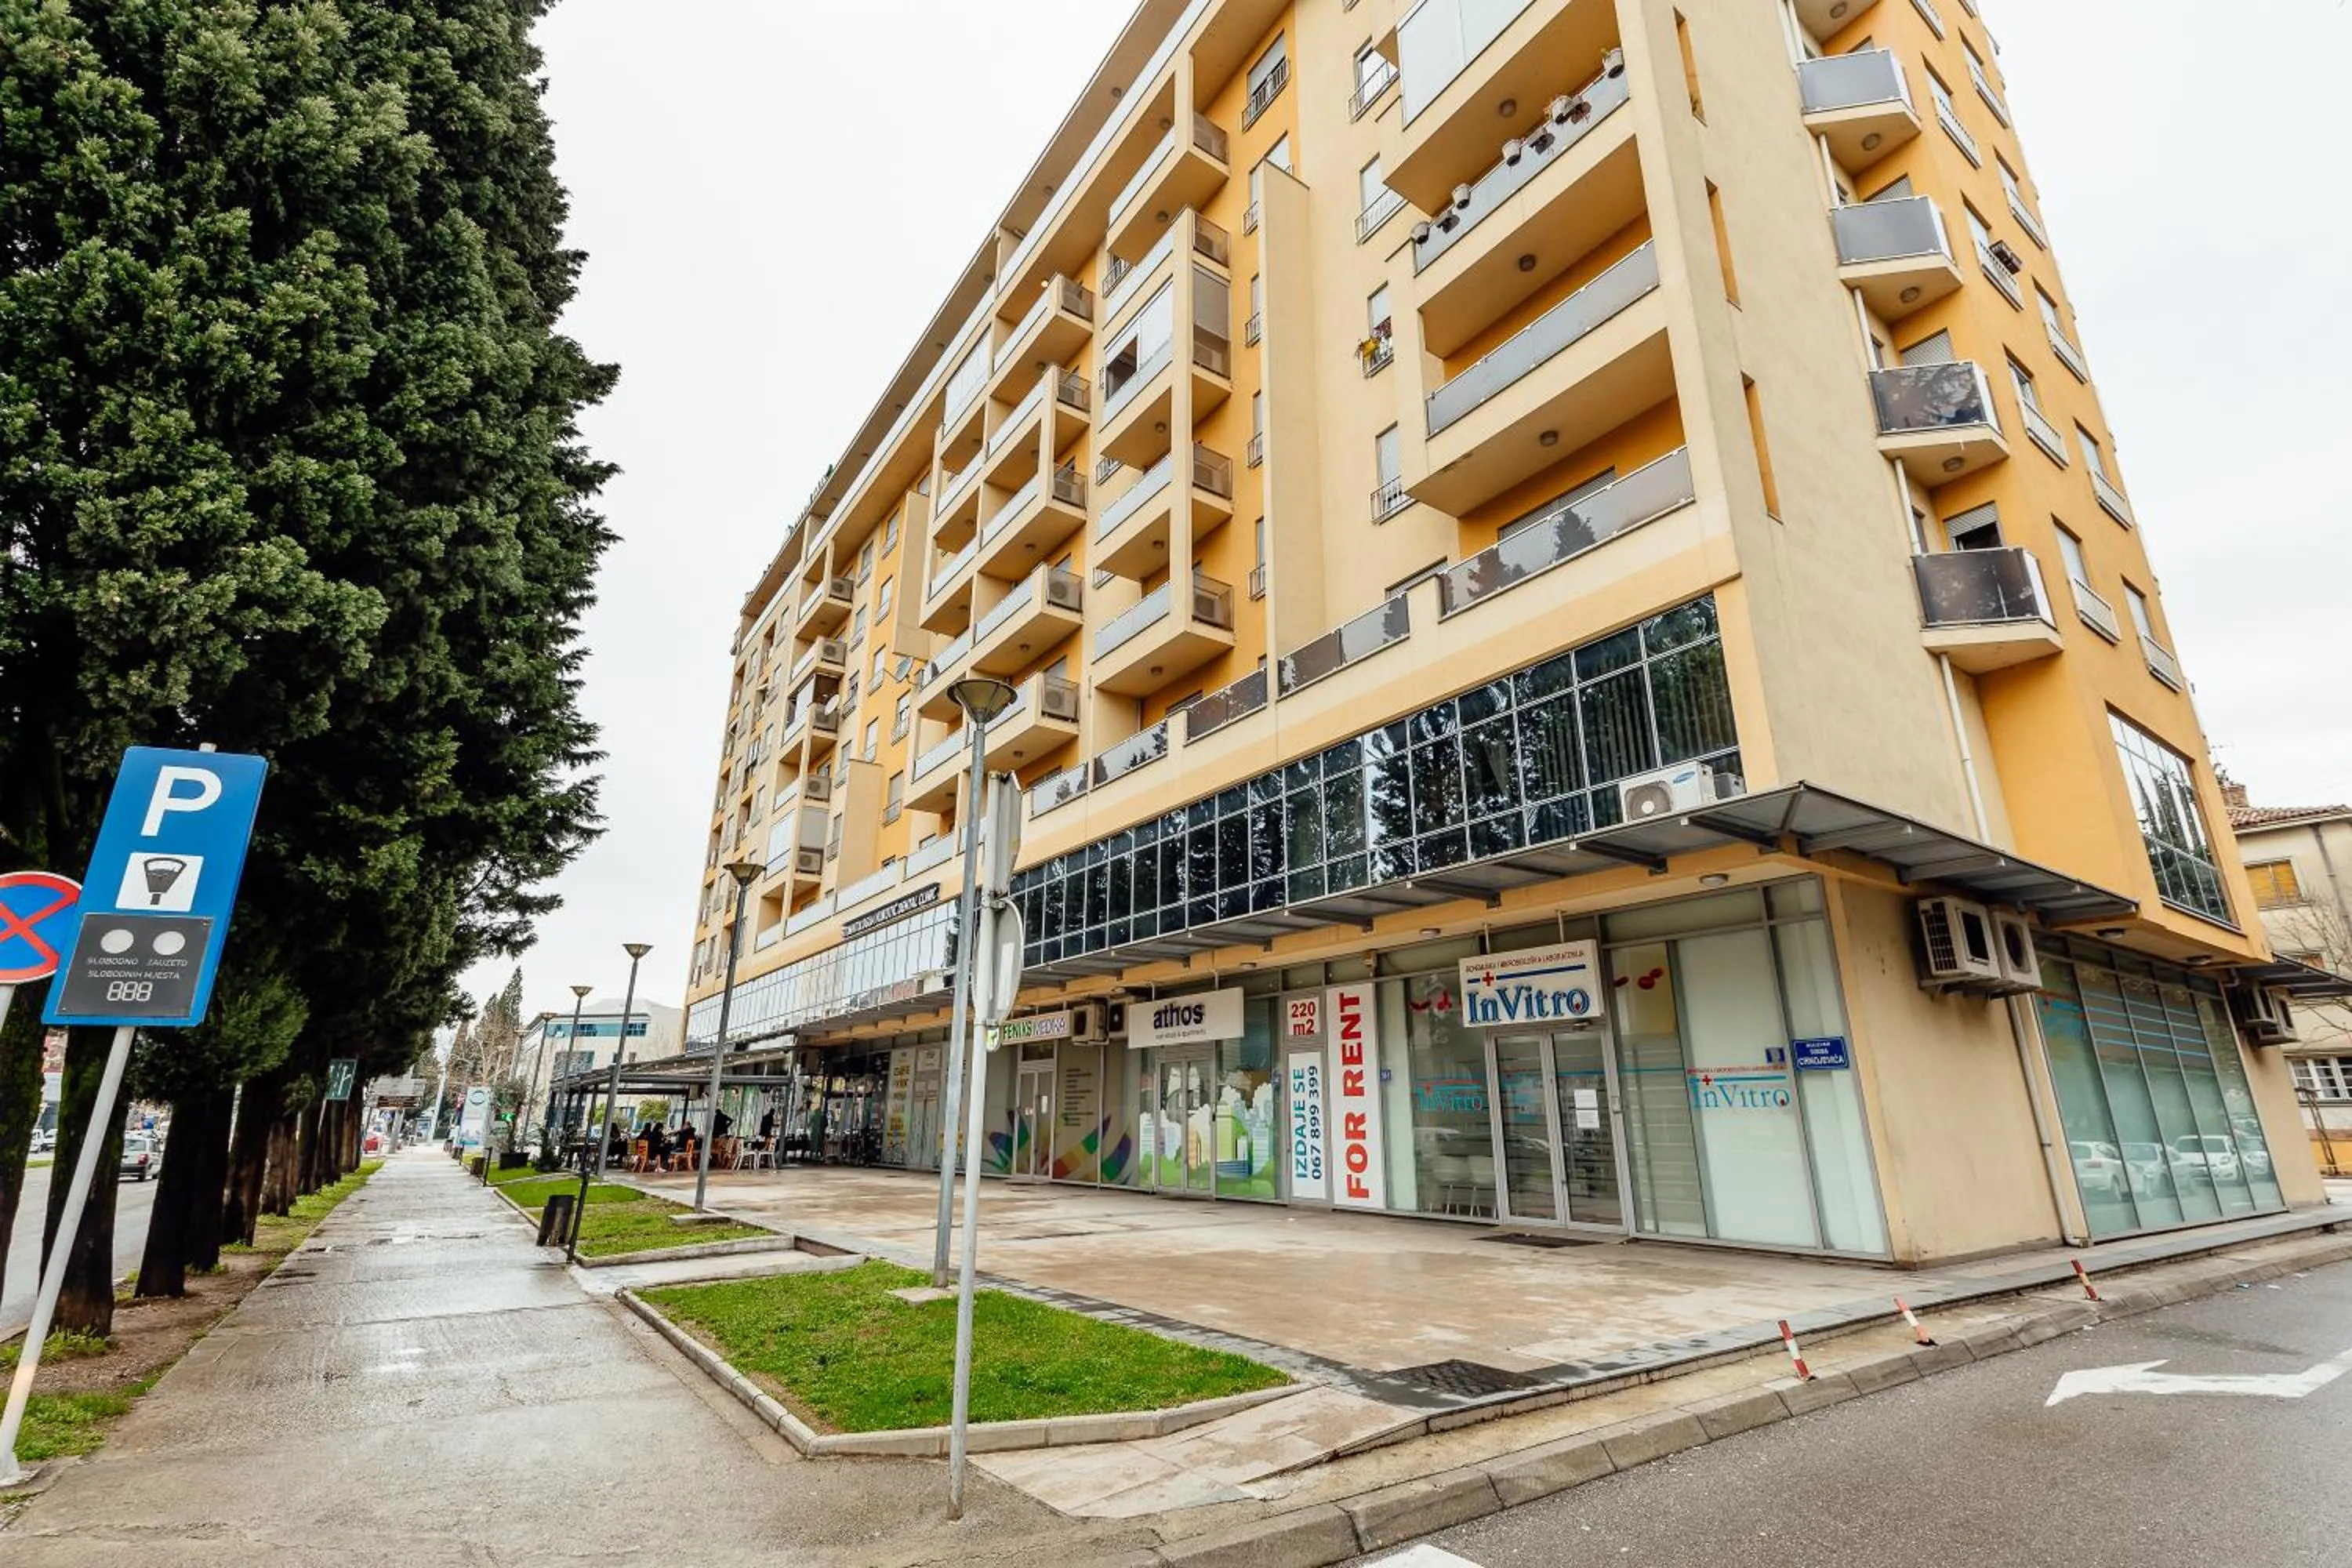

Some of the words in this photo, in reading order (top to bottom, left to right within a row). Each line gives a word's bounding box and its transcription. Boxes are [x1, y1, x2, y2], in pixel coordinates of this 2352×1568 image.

[140, 765, 222, 837] P
[87, 956, 139, 965] SLOBODNO
[88, 970, 143, 978] SLOBODNIH
[143, 971, 180, 979] MJESTA
[1154, 1003, 1205, 1029] athos
[1291, 1001, 1316, 1018] 220
[1467, 985, 1590, 1024] InVitro
[1003, 1021, 1032, 1039] FENIKS
[1293, 1019, 1315, 1035] m2
[1339, 992, 1365, 1098] RENT
[1293, 1068, 1306, 1092] SE
[1308, 1065, 1319, 1098] 399
[1691, 1083, 1791, 1108] InVitro
[1309, 1105, 1321, 1139] 899
[1293, 1099, 1308, 1178] IZDAJE
[1311, 1144, 1322, 1179] 067
[1345, 1112, 1370, 1200] FOR
